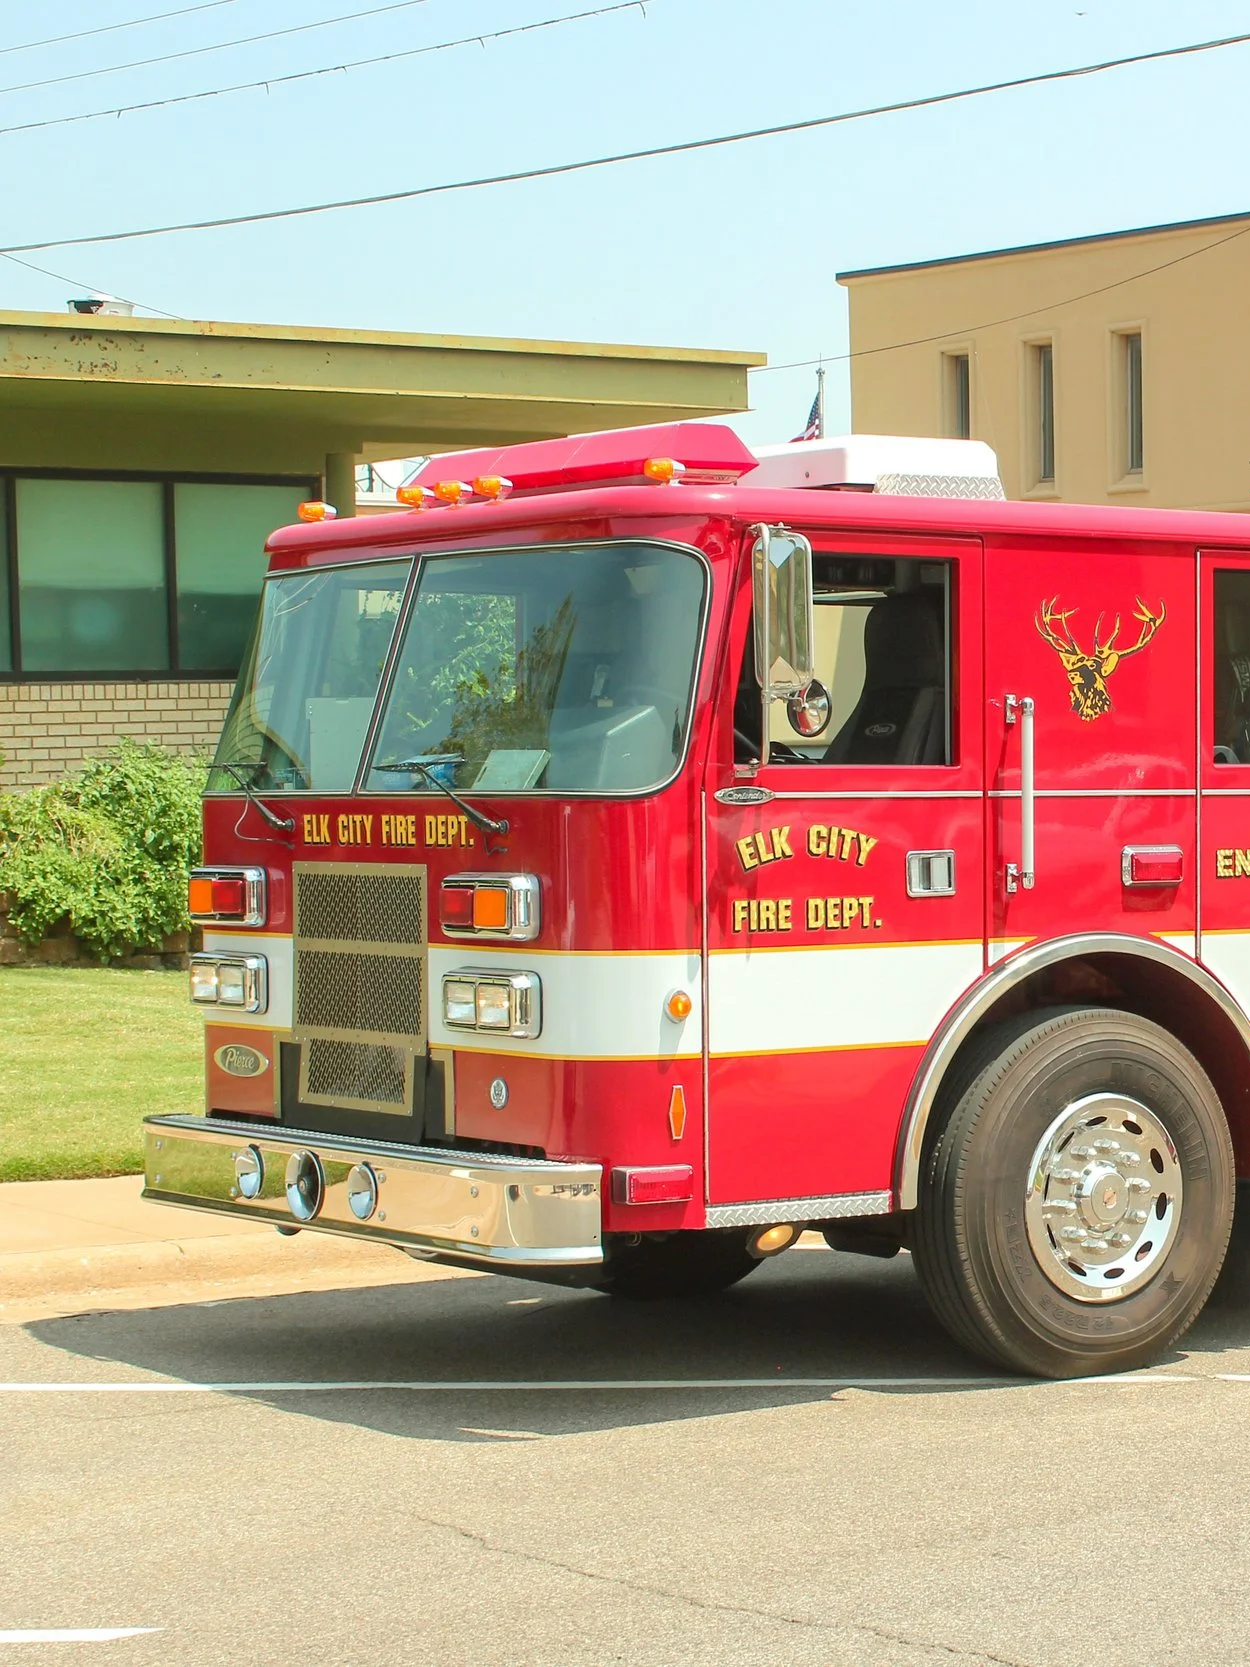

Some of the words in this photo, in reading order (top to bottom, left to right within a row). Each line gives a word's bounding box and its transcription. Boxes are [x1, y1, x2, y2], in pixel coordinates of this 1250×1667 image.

[303, 814, 331, 845] ELK
[337, 814, 373, 846] CITY
[381, 815, 416, 847] FIRE
[424, 815, 474, 847] DEPT.
[736, 826, 793, 872] ELK
[807, 825, 878, 866] CITY
[733, 899, 792, 932] FIRE
[806, 897, 882, 930] DEPT.
[225, 1048, 255, 1069] Pierce
